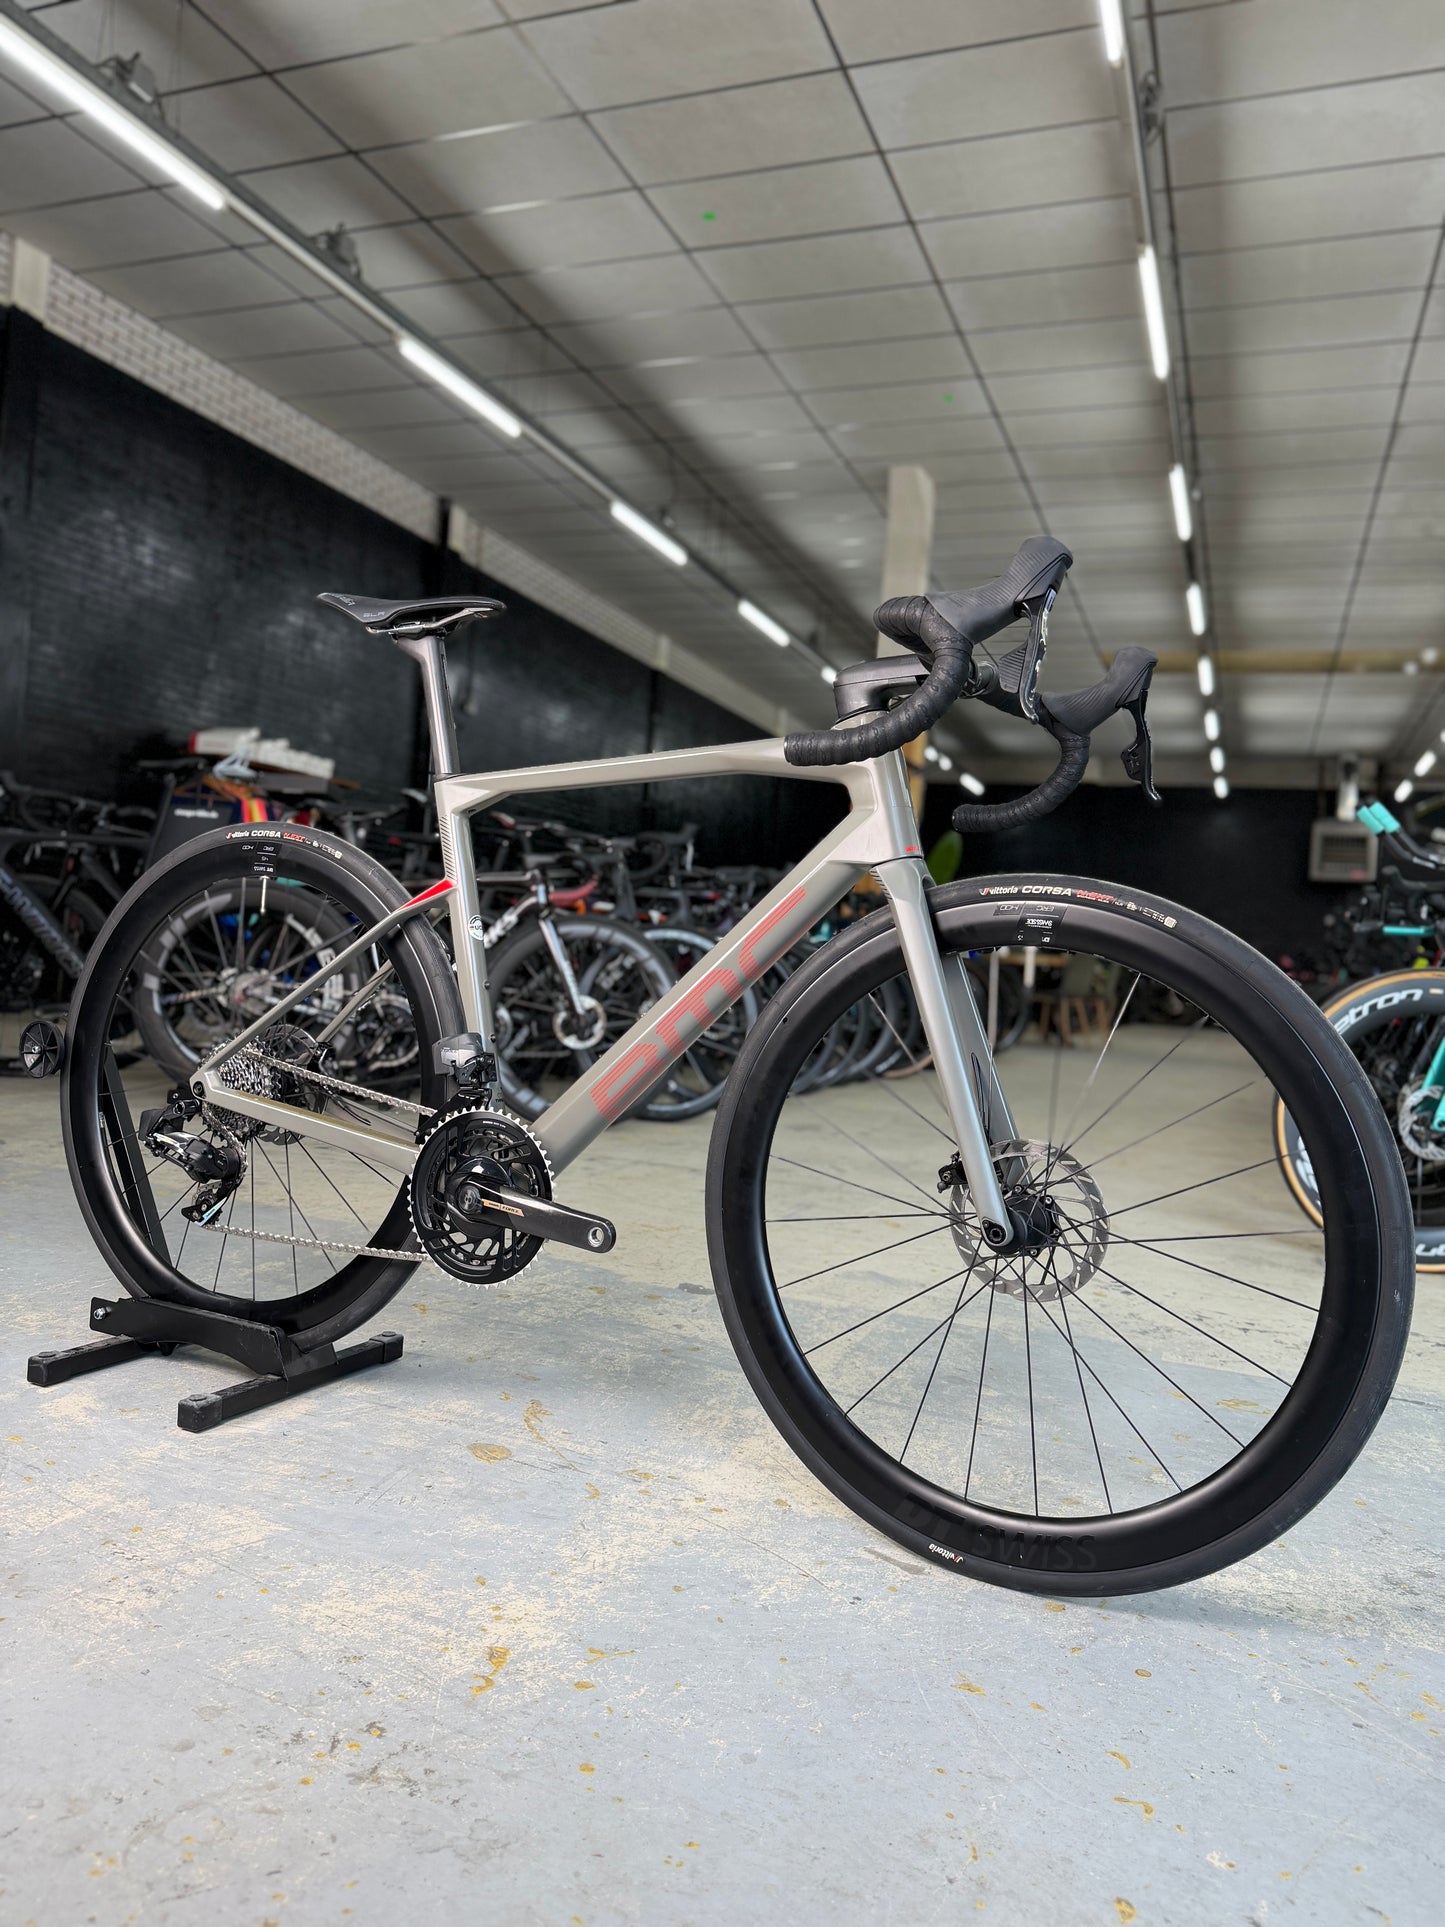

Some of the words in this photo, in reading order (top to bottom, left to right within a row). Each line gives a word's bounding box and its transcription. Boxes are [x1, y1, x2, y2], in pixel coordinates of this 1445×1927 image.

[251, 829, 281, 839] CORSA
[989, 886, 1018, 896] vittoria
[1021, 885, 1072, 897] CORSA
[1334, 988, 1424, 1036] etron
[928, 1543, 956, 1560] vittoria
[973, 1524, 1097, 1571] SWISS
